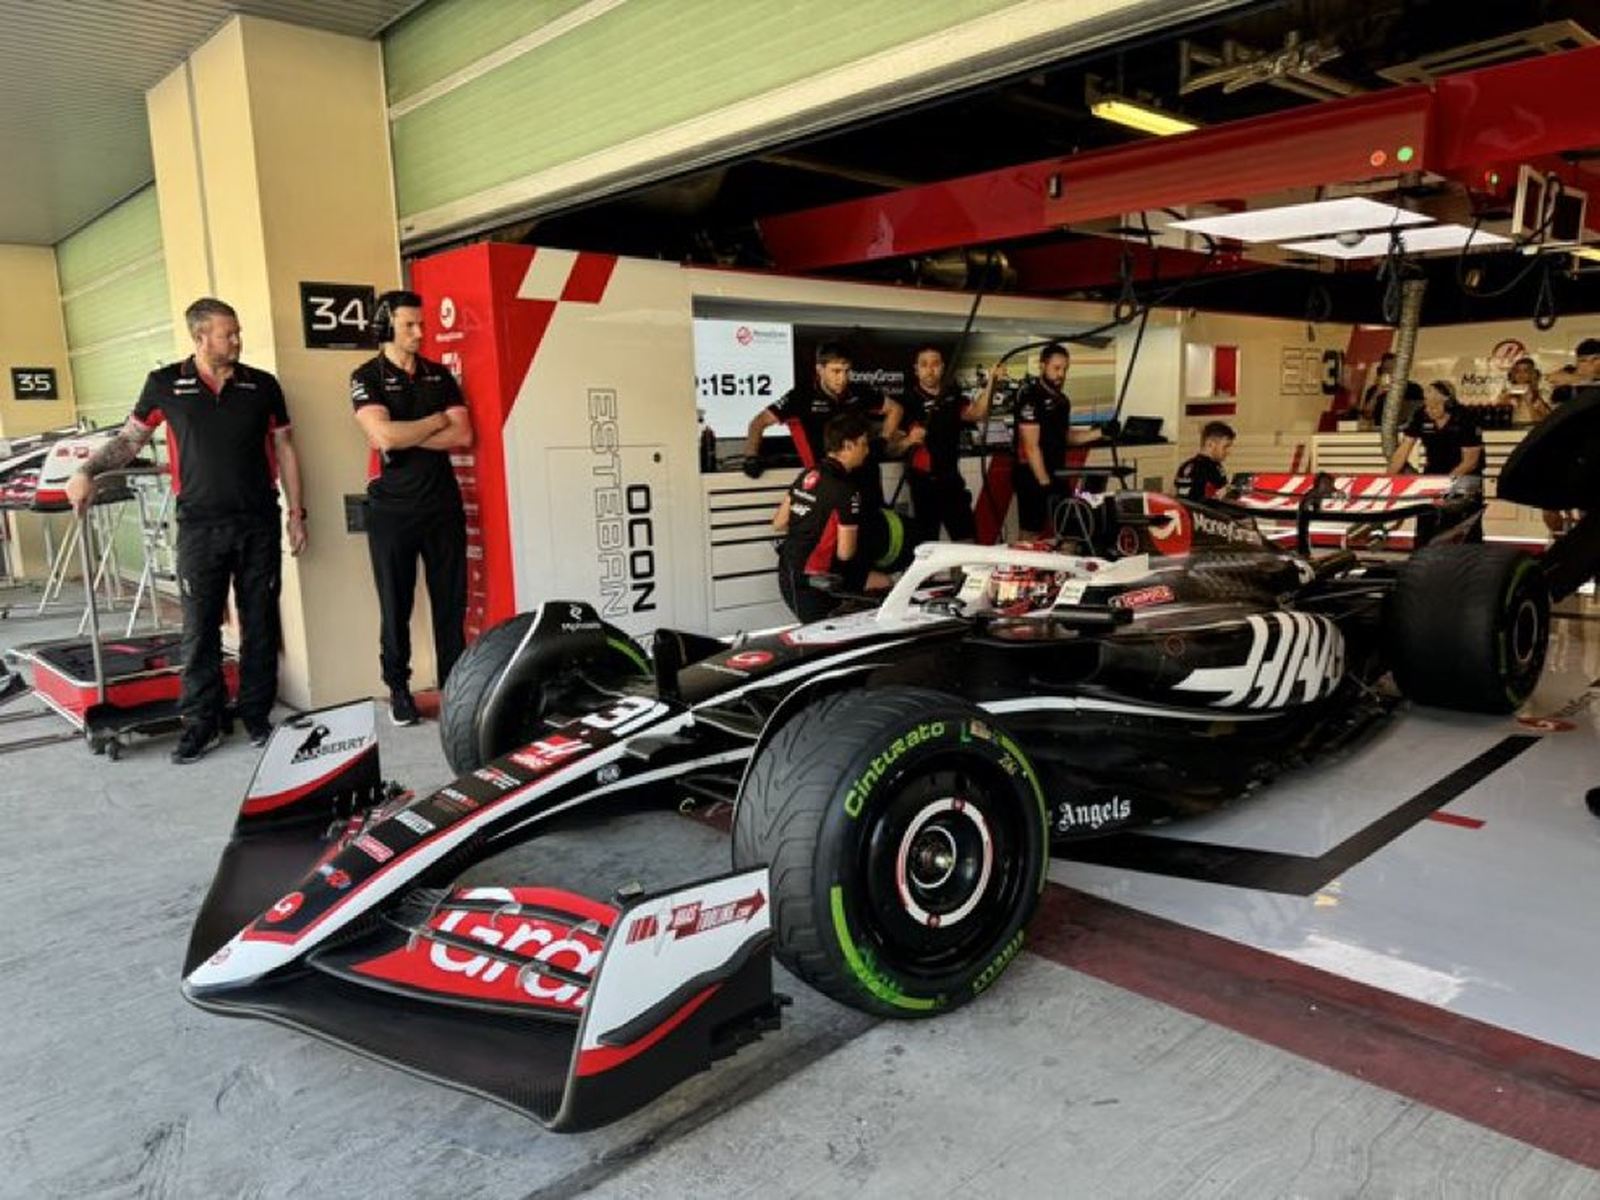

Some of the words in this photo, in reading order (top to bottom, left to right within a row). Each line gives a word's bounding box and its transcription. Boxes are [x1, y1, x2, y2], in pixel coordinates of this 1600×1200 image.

[309, 296, 369, 331] 34
[16, 373, 52, 391] 35
[695, 373, 772, 396] :15:12
[588, 388, 628, 618] ESTEBAN
[626, 484, 657, 613] OCON
[1058, 795, 1131, 832] Angels
